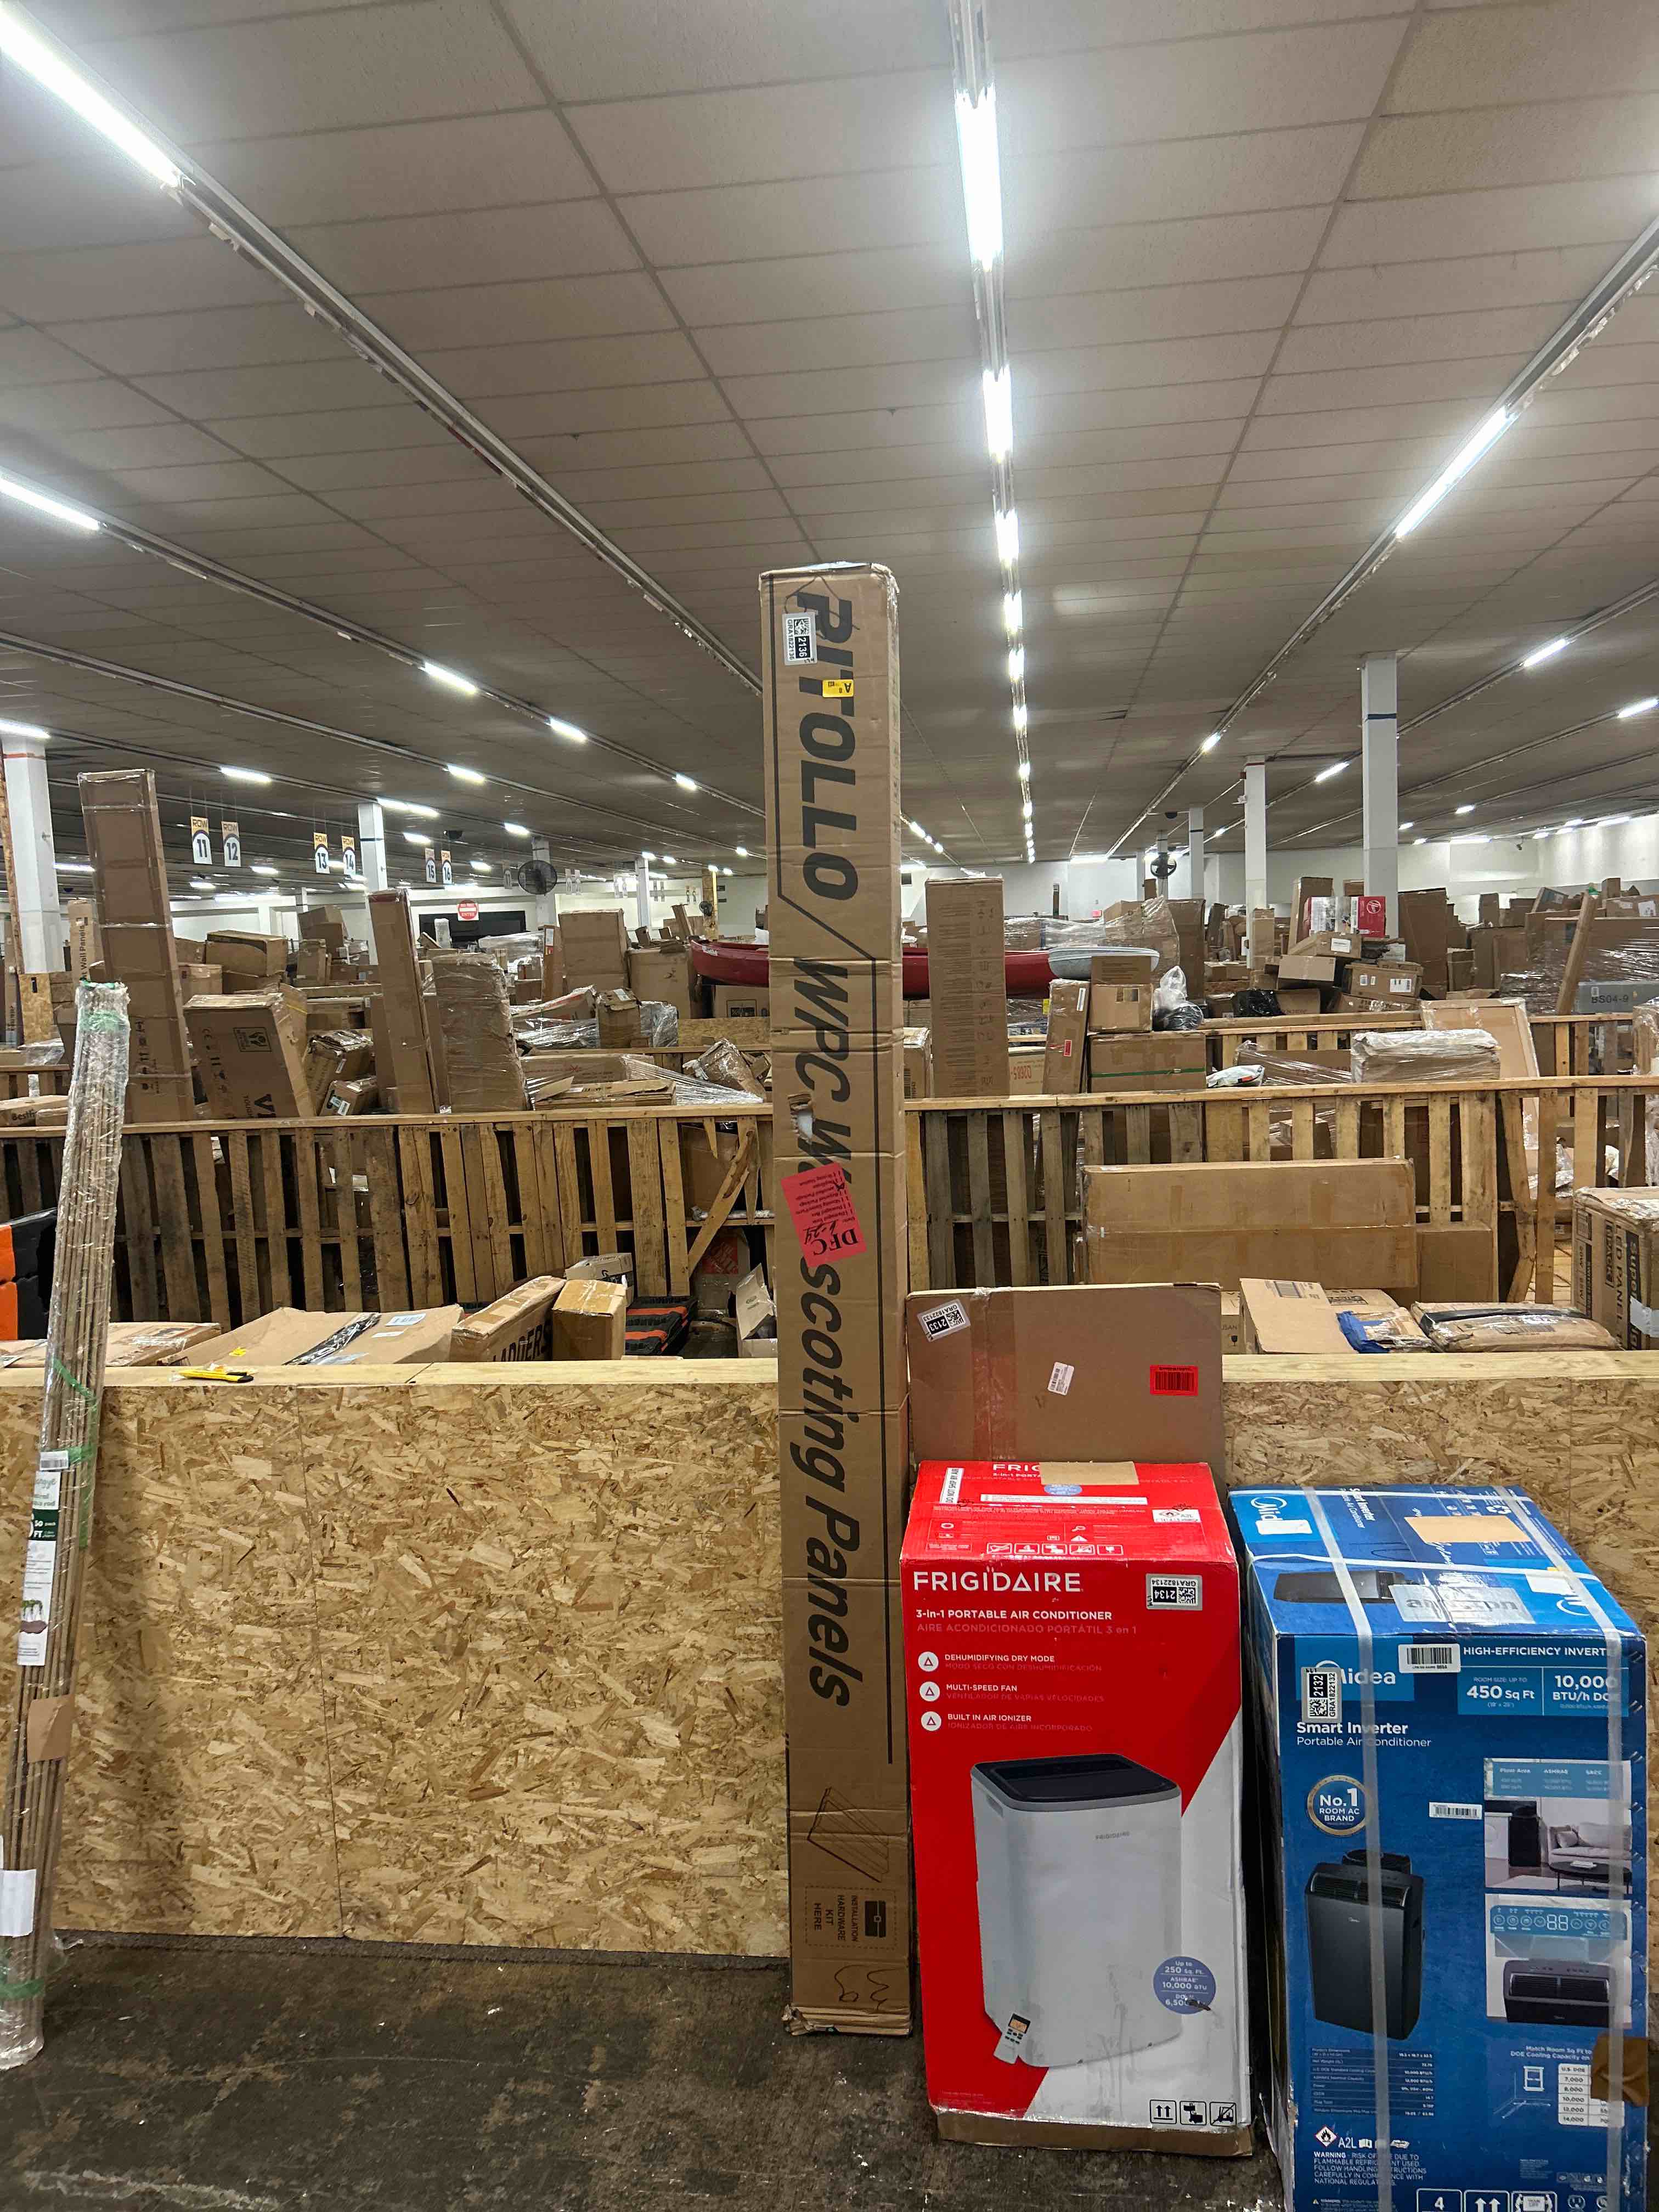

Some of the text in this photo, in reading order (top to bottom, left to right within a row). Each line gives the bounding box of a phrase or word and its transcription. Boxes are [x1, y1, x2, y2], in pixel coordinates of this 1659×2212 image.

[798, 637, 808, 657] 2136
[798, 590, 857, 900] RITOLLO
[193, 819, 207, 827] ROW
[197, 839, 207, 857] 11
[227, 842, 238, 860] 12
[317, 853, 327, 868] 13
[345, 854, 354, 870] 14
[427, 865, 435, 878] 15
[443, 867, 451, 881] 16
[80, 950, 88, 968] Wall
[793, 957, 851, 1102] WPC
[811, 1228, 858, 1255] DFC
[929, 1318, 947, 1332] 2133
[789, 1118, 863, 1707] Wscoting Panels
[1357, 1501, 1376, 1521] Inverter
[913, 1571, 1081, 1592] FRIGIDAIRE
[1154, 1590, 1176, 1600] 2134
[916, 1609, 1113, 1621] 3-in-1 PORTABLE AIR CONDITIONER
[917, 1623, 943, 1633] AIRE
[946, 1623, 1043, 1633] ACONDICIONADO
[1463, 1647, 1612, 1656] HIGH-EFFICIENCY INVERT
[1313, 1674, 1324, 1697] 2132
[1554, 1675, 1617, 1691] 10,000
[1466, 1685, 1534, 1700] 450 Sq Ft
[1553, 1692, 1617, 1702] BTU/h DO
[1296, 1722, 1343, 1734] Smart
[1297, 1736, 1344, 1746] Portable
[1346, 1737, 1363, 1746] Air
[1095, 1831, 1131, 1840] FRIGIDAIRE
[814, 1903, 822, 1932] HERE
[825, 1909, 834, 1926] KIT
[837, 1894, 845, 1941] HARDWARE
[851, 1895, 859, 1942] INSTALLATION
[1163, 1982, 1192, 1990] 10,000
[1338, 2137, 1357, 2149] A2L
[1435, 2197, 1445, 2211] 4
